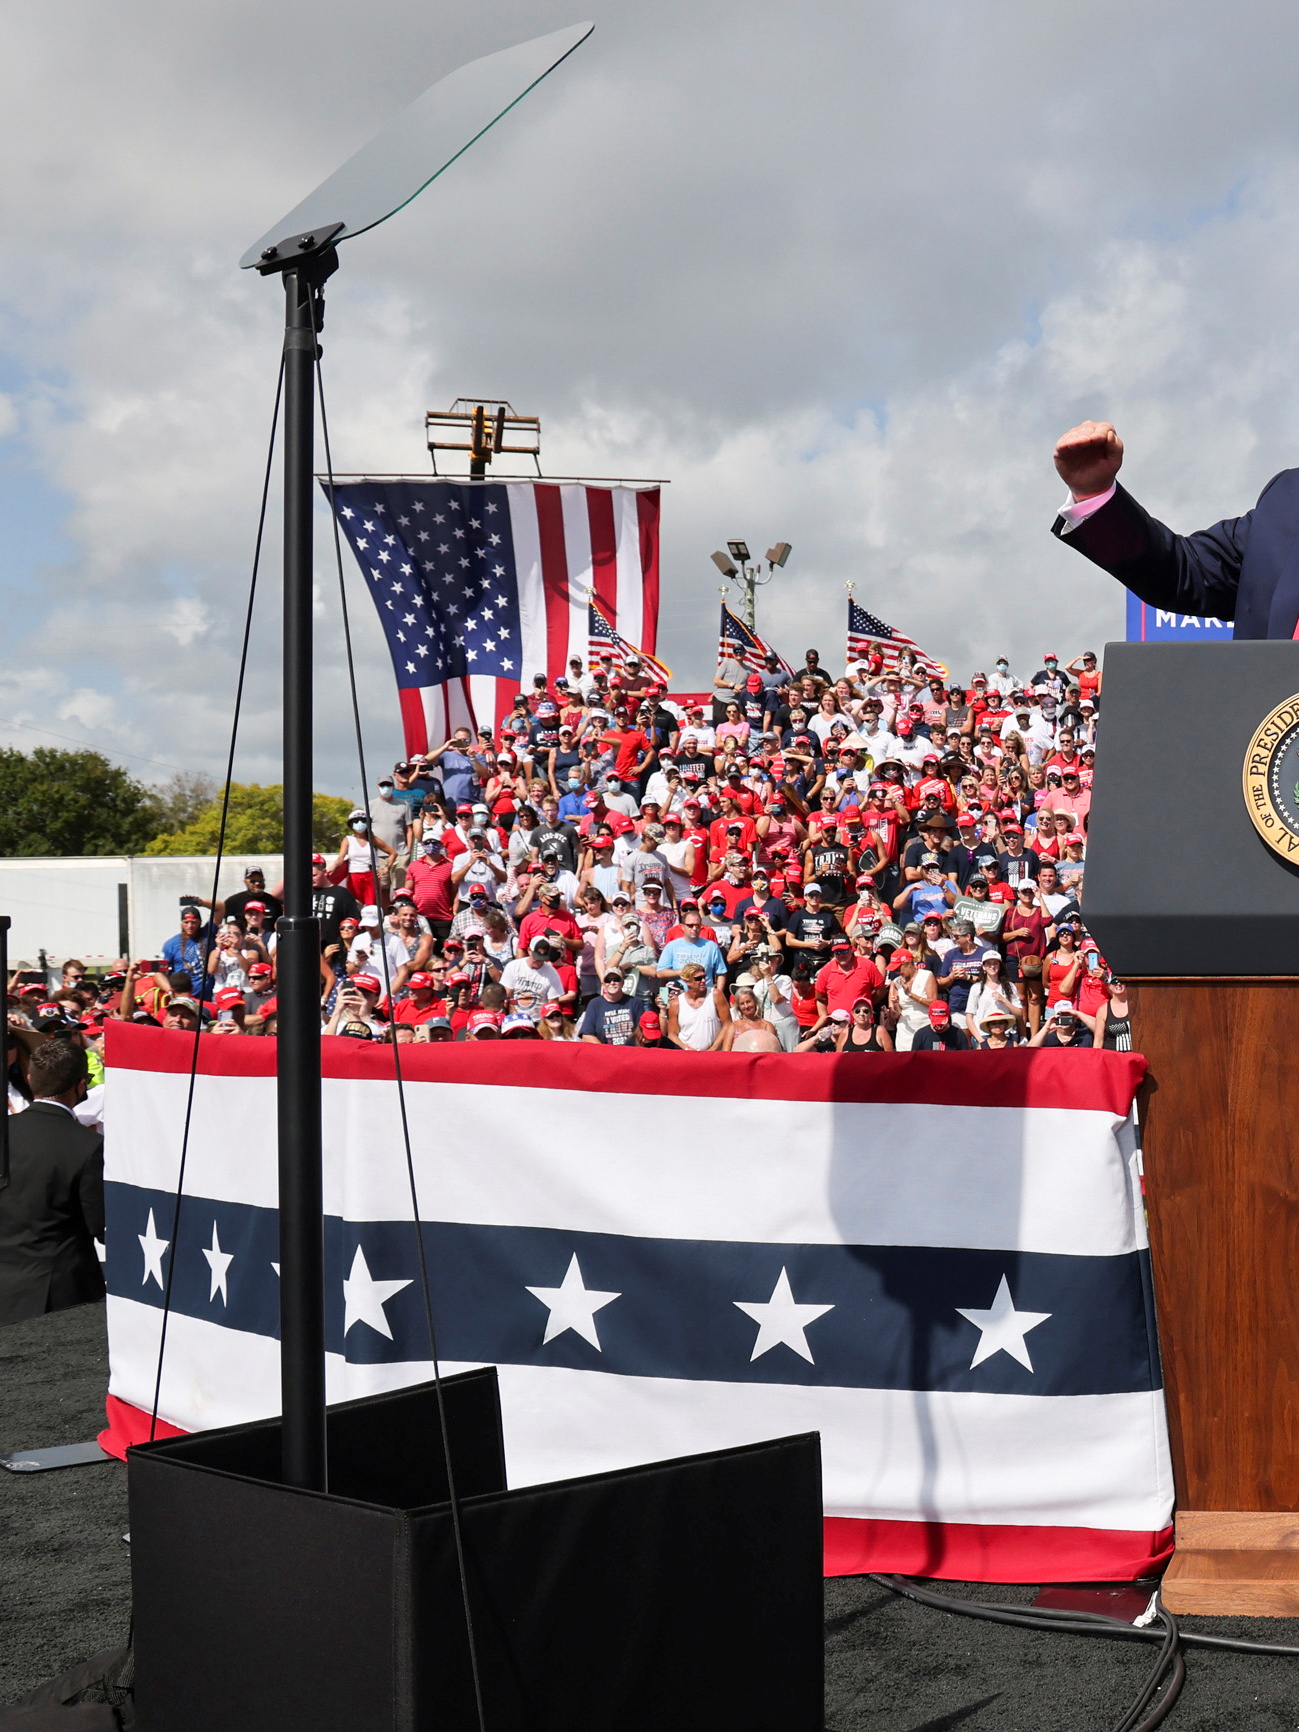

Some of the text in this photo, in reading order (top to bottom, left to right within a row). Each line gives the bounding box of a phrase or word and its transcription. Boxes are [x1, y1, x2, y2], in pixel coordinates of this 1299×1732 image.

[1155, 608, 1235, 628] MAK
[1252, 784, 1265, 811] THE
[1262, 813, 1275, 829] OF
[961, 908, 998, 920] VETERANS
[517, 976, 543, 991] Trump
